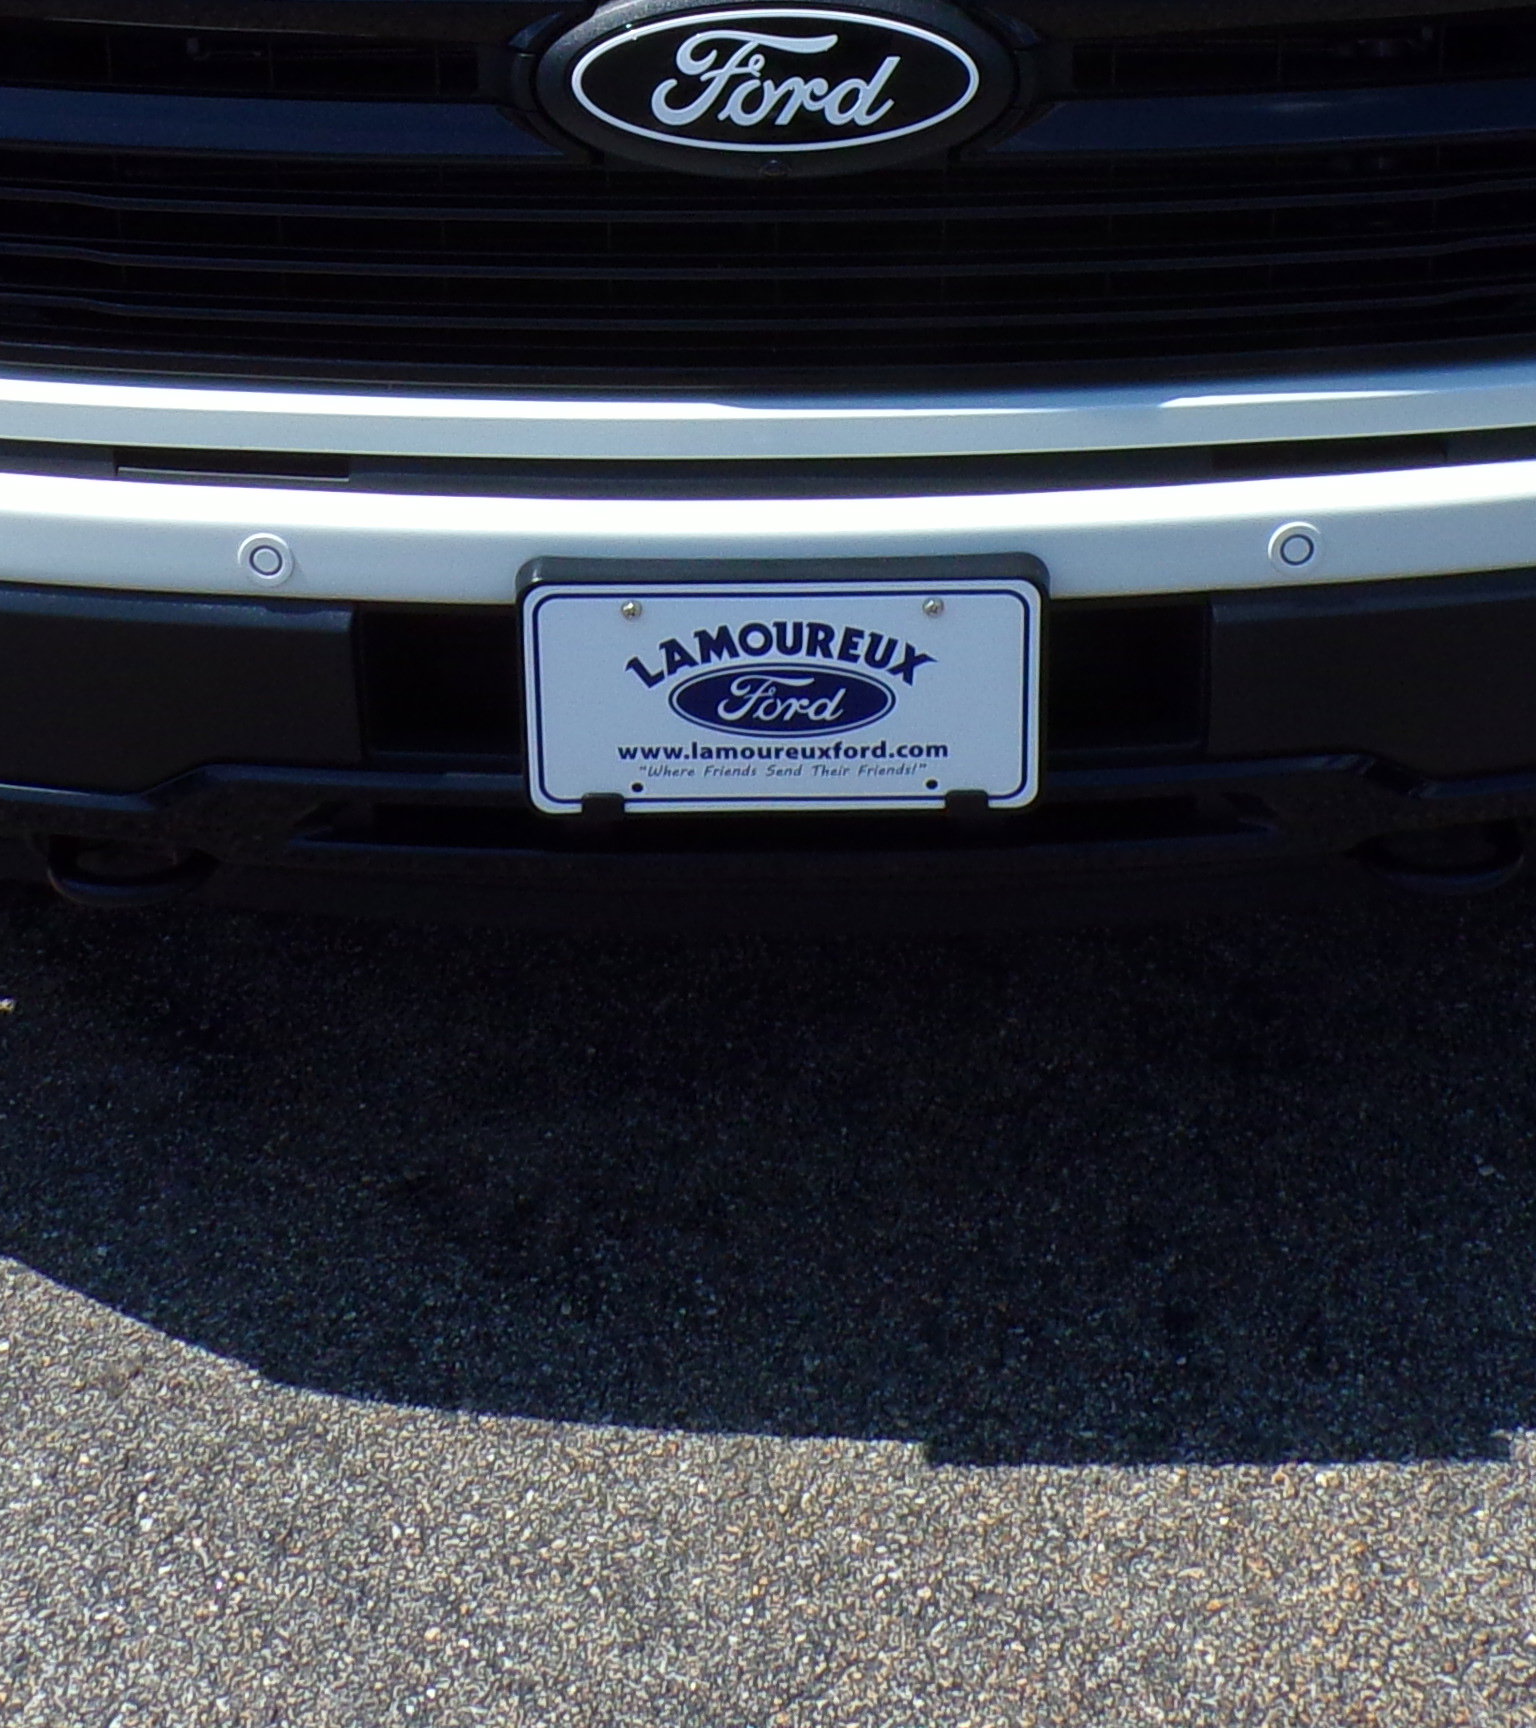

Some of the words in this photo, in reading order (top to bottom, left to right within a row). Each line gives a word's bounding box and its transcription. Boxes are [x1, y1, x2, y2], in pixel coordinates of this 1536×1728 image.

[651, 29, 901, 127] Ford
[625, 621, 939, 689] LAMOUREUX
[717, 674, 847, 721] Ford
[617, 740, 949, 761] www.lamoureuxford.com
[704, 765, 757, 777] Friends
[765, 764, 803, 777] Send
[812, 764, 851, 777] Their
